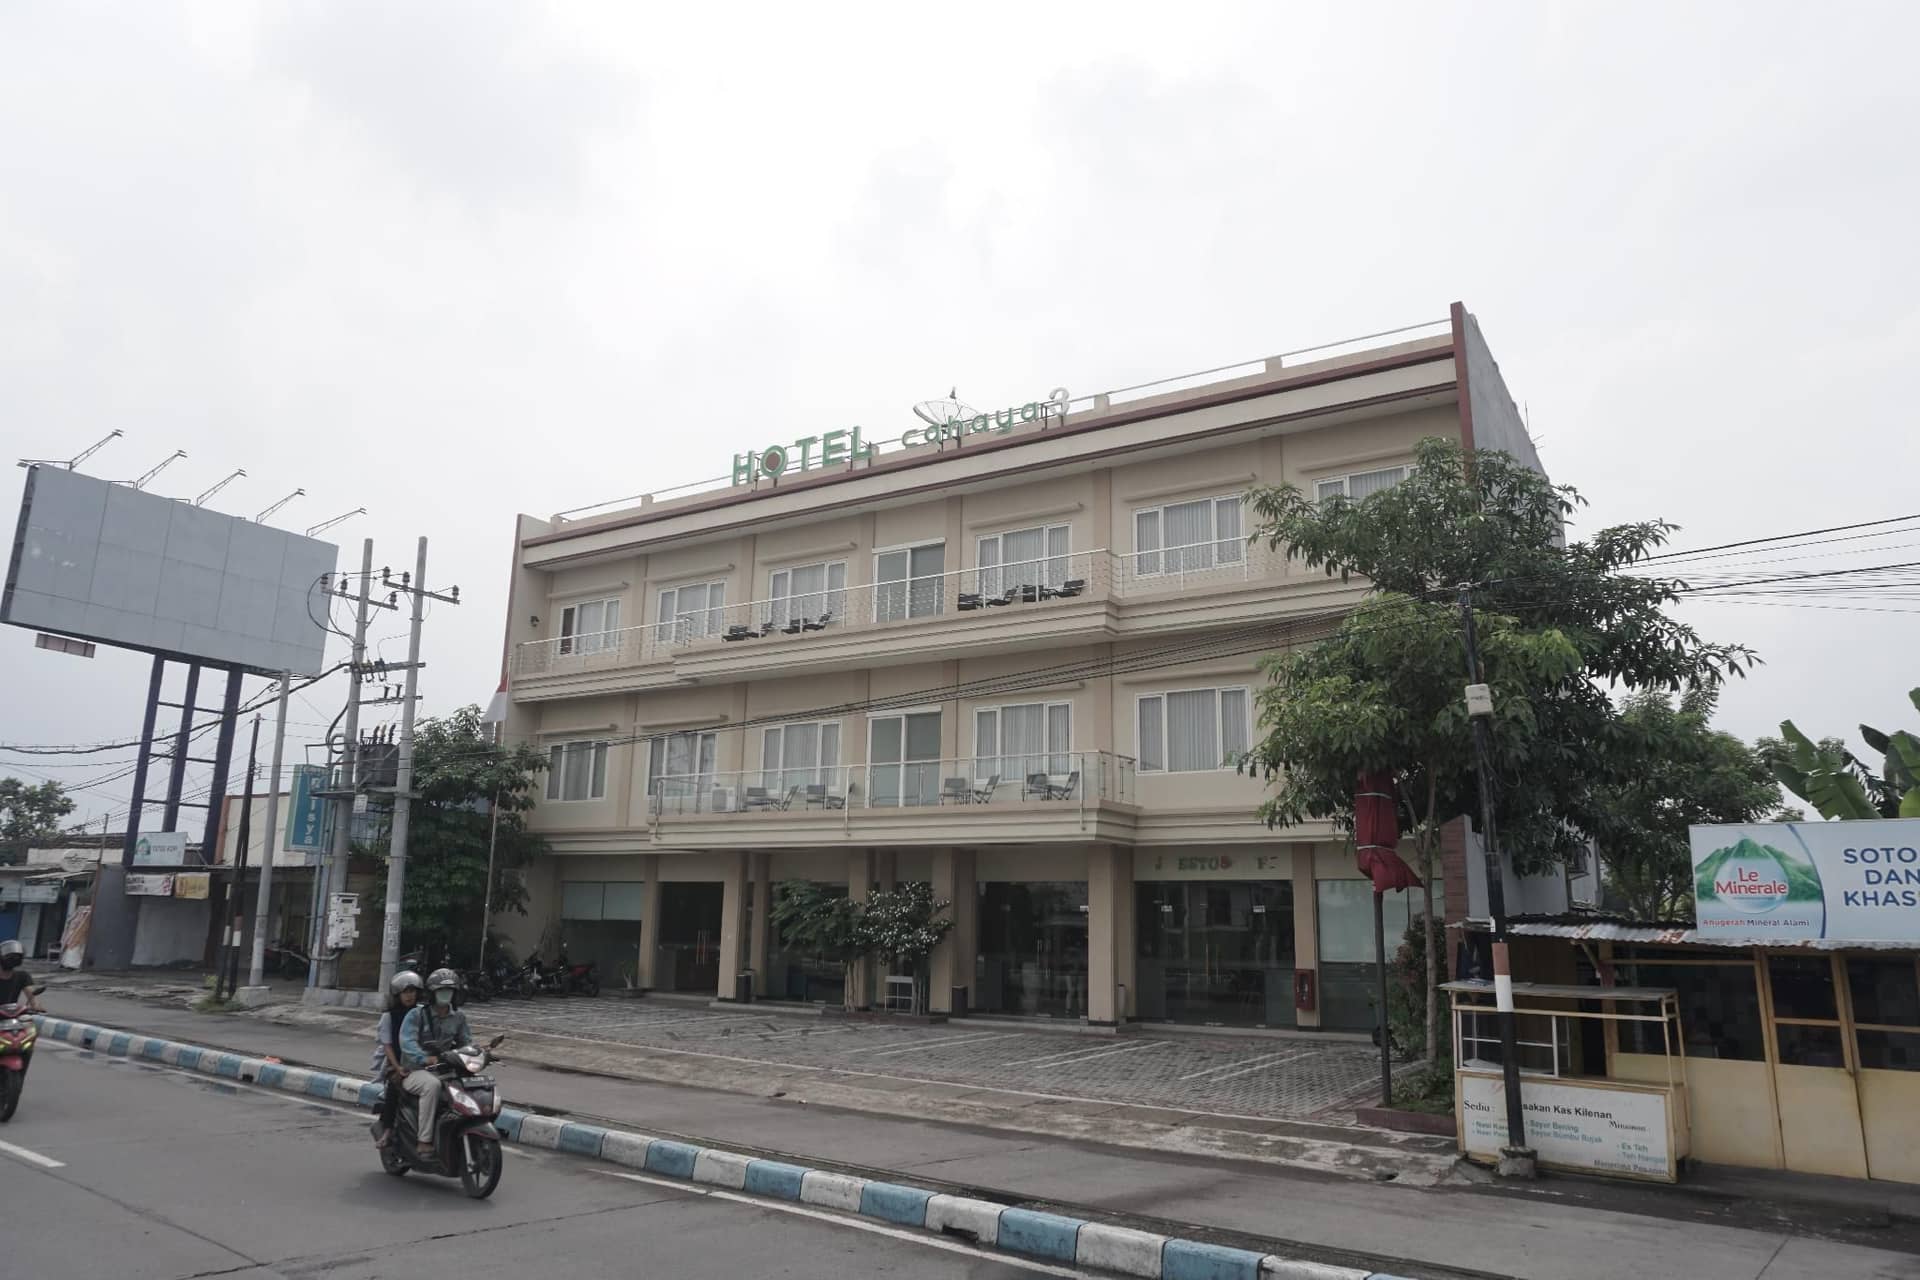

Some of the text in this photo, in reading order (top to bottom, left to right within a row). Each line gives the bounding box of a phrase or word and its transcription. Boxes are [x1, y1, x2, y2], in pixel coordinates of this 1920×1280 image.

[733, 387, 1069, 487] HOTEL cahaya 3
[1843, 847, 1917, 864] SOTO
[1738, 867, 1759, 882] Le
[1865, 869, 1920, 885] DAN
[1715, 881, 1788, 894] Minerale
[1844, 890, 1917, 906] KHAS
[1703, 918, 1810, 928] Anugerah Mineral Alami
[1553, 1105, 1572, 1115] Kas
